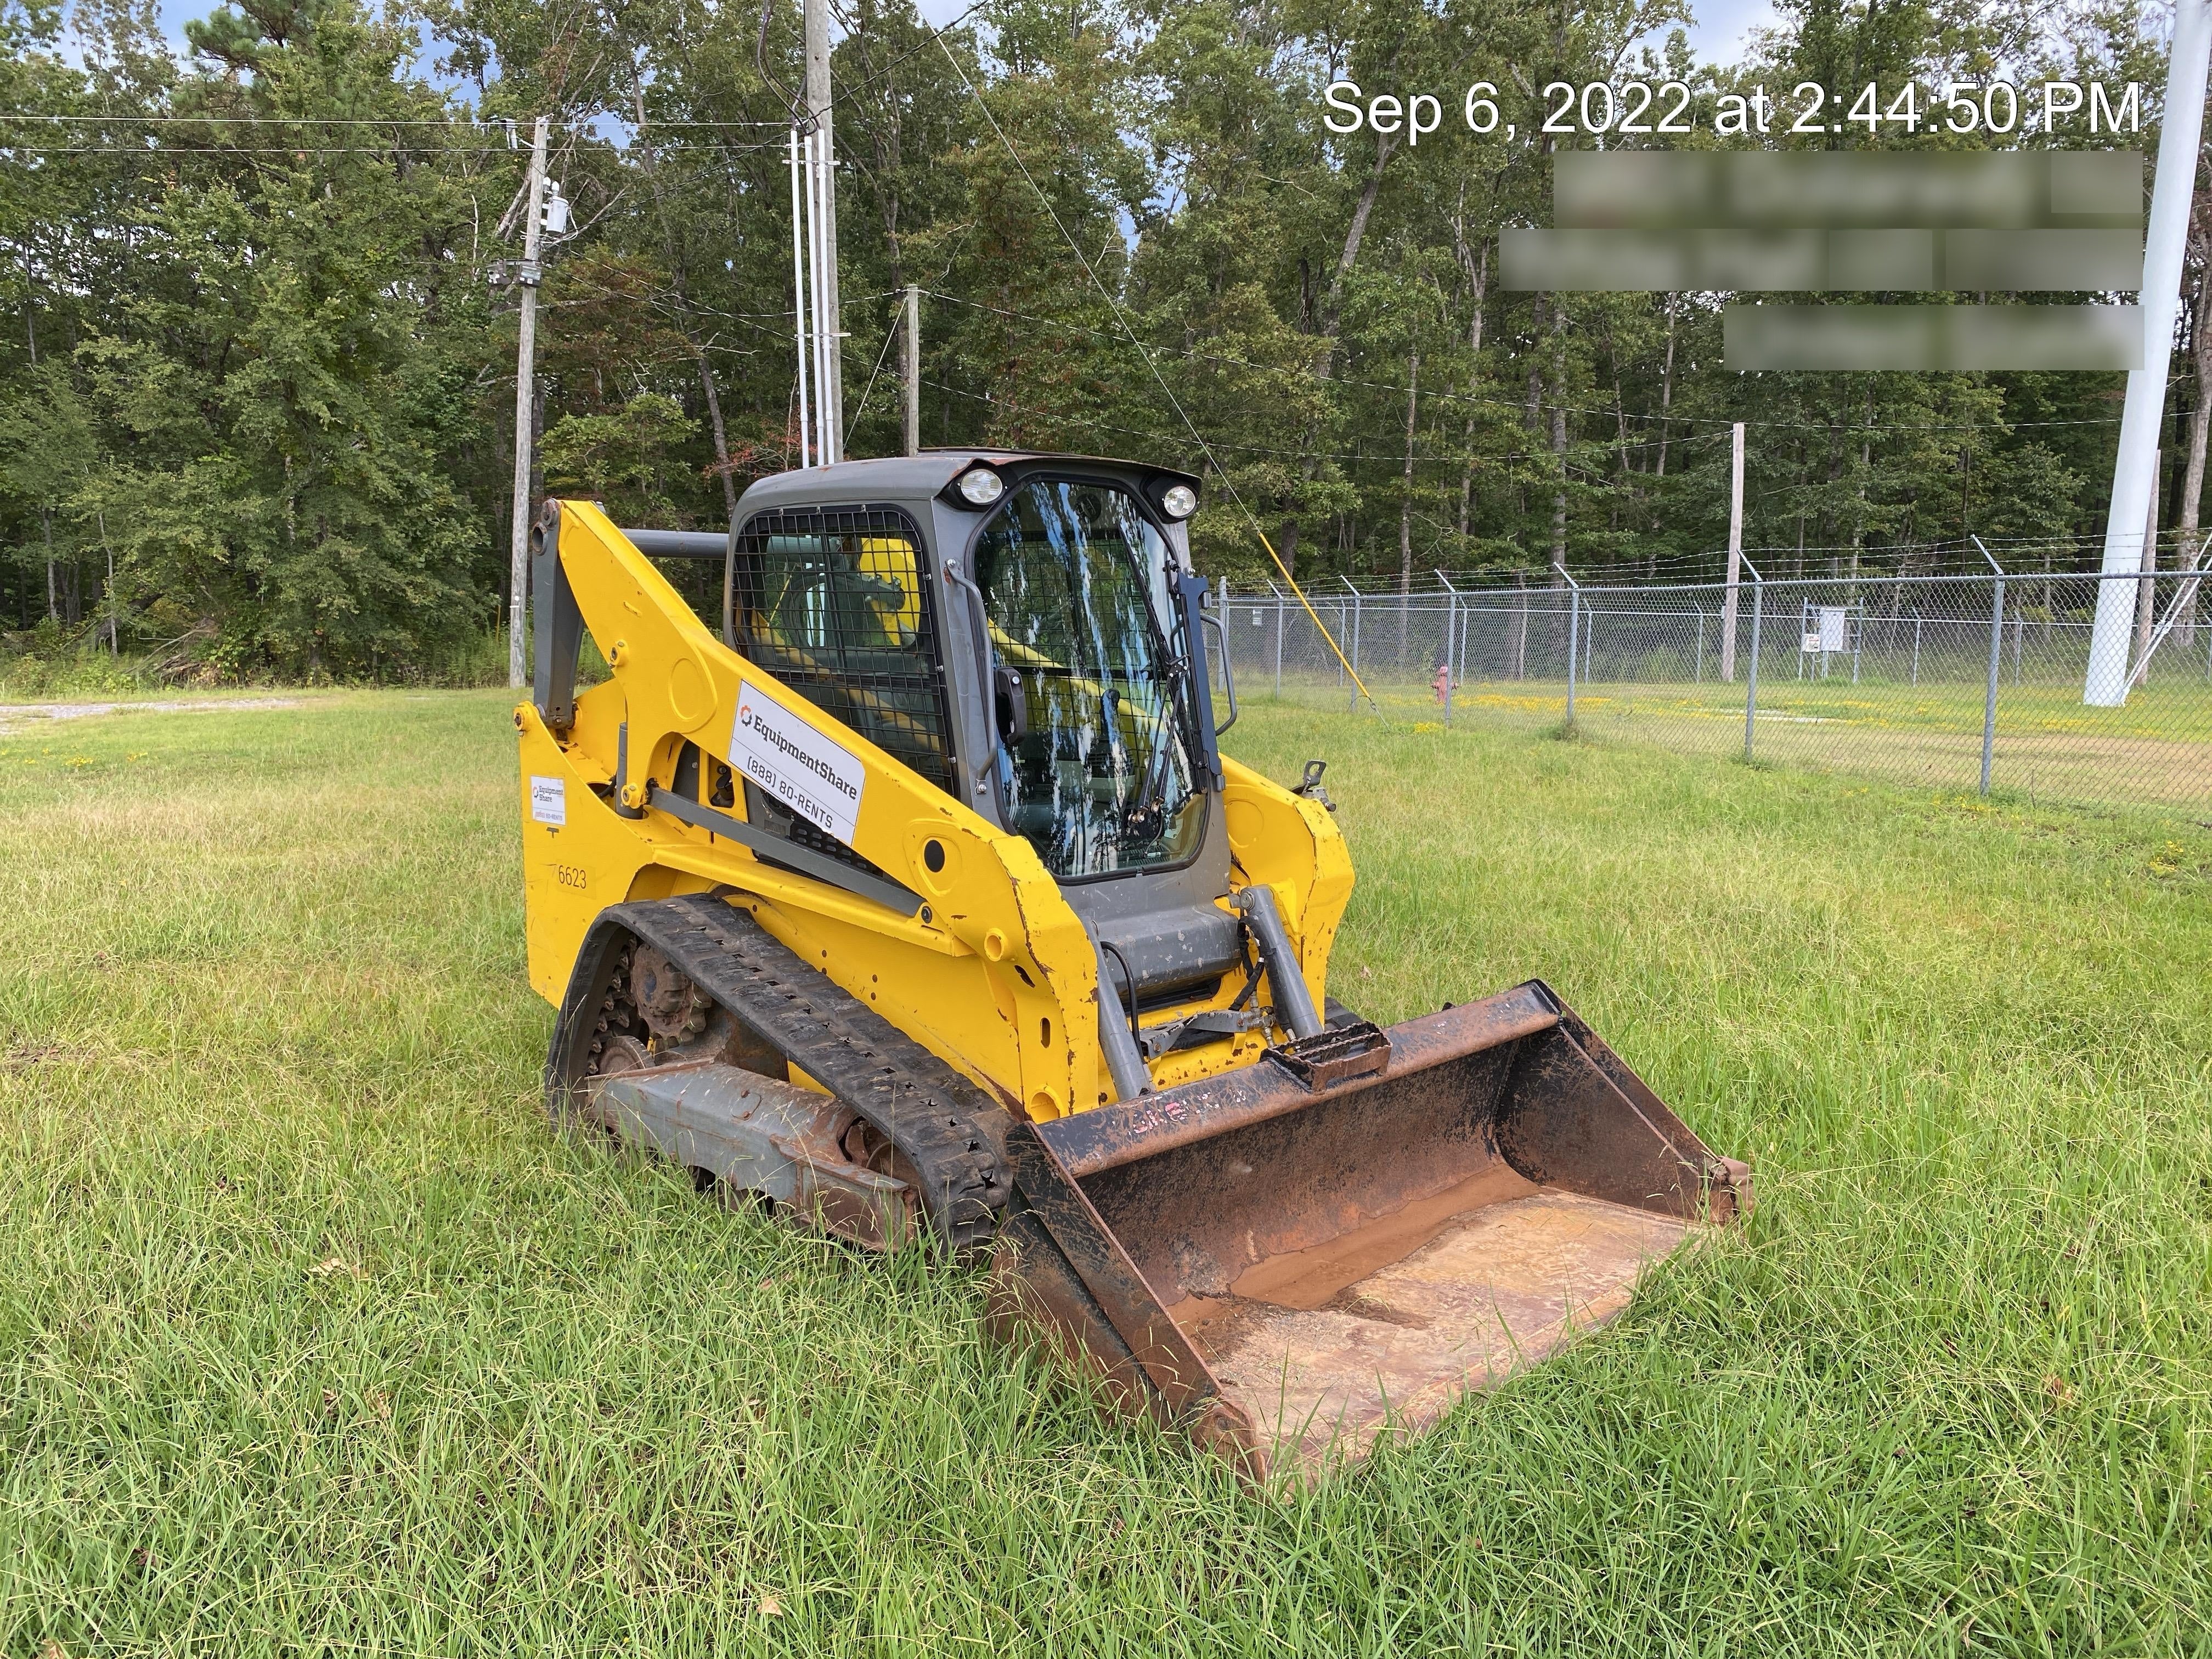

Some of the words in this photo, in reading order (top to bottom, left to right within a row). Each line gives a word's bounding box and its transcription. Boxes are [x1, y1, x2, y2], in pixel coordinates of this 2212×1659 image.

[753, 714, 857, 800] EquipmentShare
[539, 785, 563, 795] Equipment
[539, 794, 553, 803] Share
[747, 755, 777, 788] (888)
[779, 781, 833, 829] 80-RENTS
[558, 865, 586, 889] 6623
